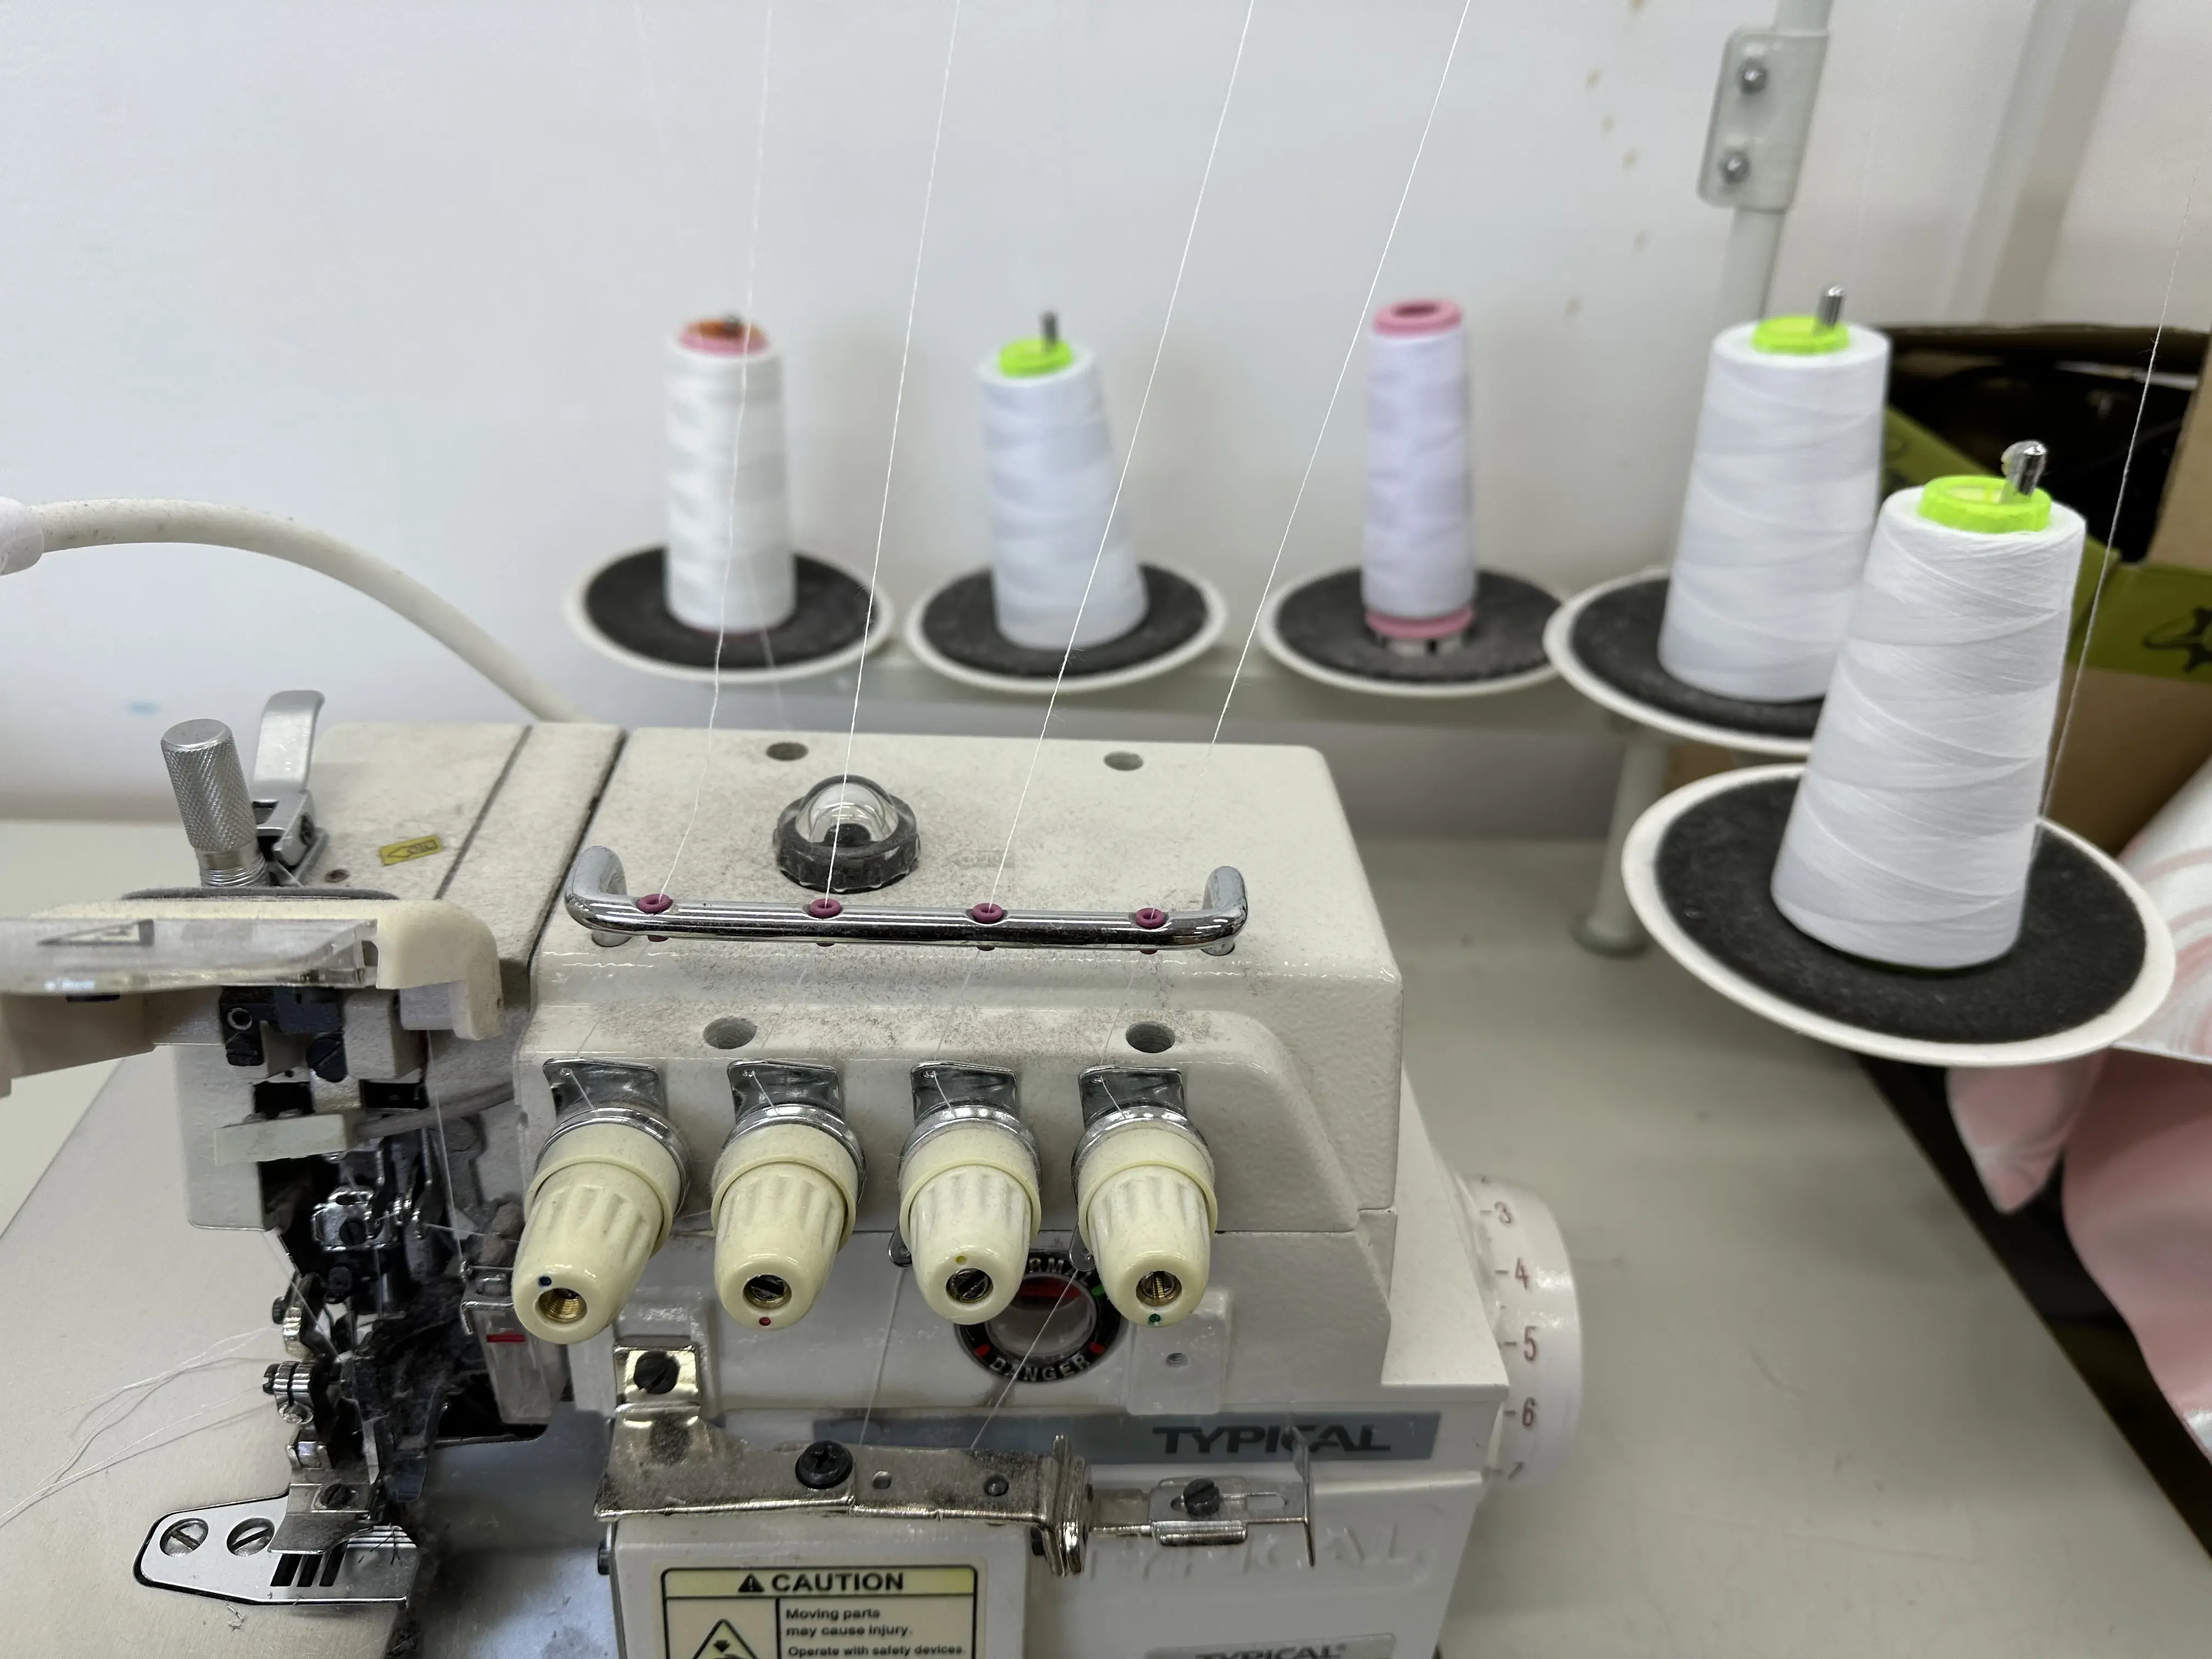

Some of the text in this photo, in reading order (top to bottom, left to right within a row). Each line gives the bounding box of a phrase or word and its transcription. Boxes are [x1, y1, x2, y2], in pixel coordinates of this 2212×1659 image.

[1494, 1201, 1513, 1227] 3
[1515, 1257, 1530, 1290] 4
[1523, 1325, 1537, 1362] 5
[1521, 1397, 1536, 1427] 6
[1153, 1424, 1391, 1454] TYPICAL
[771, 1572, 905, 1592] CAUTION
[786, 1608, 881, 1621] Moving parts
[786, 1626, 817, 1638] may
[822, 1626, 865, 1635] cause
[788, 1645, 839, 1658] Operate
[844, 1645, 868, 1656] with
[872, 1645, 911, 1657] safety
